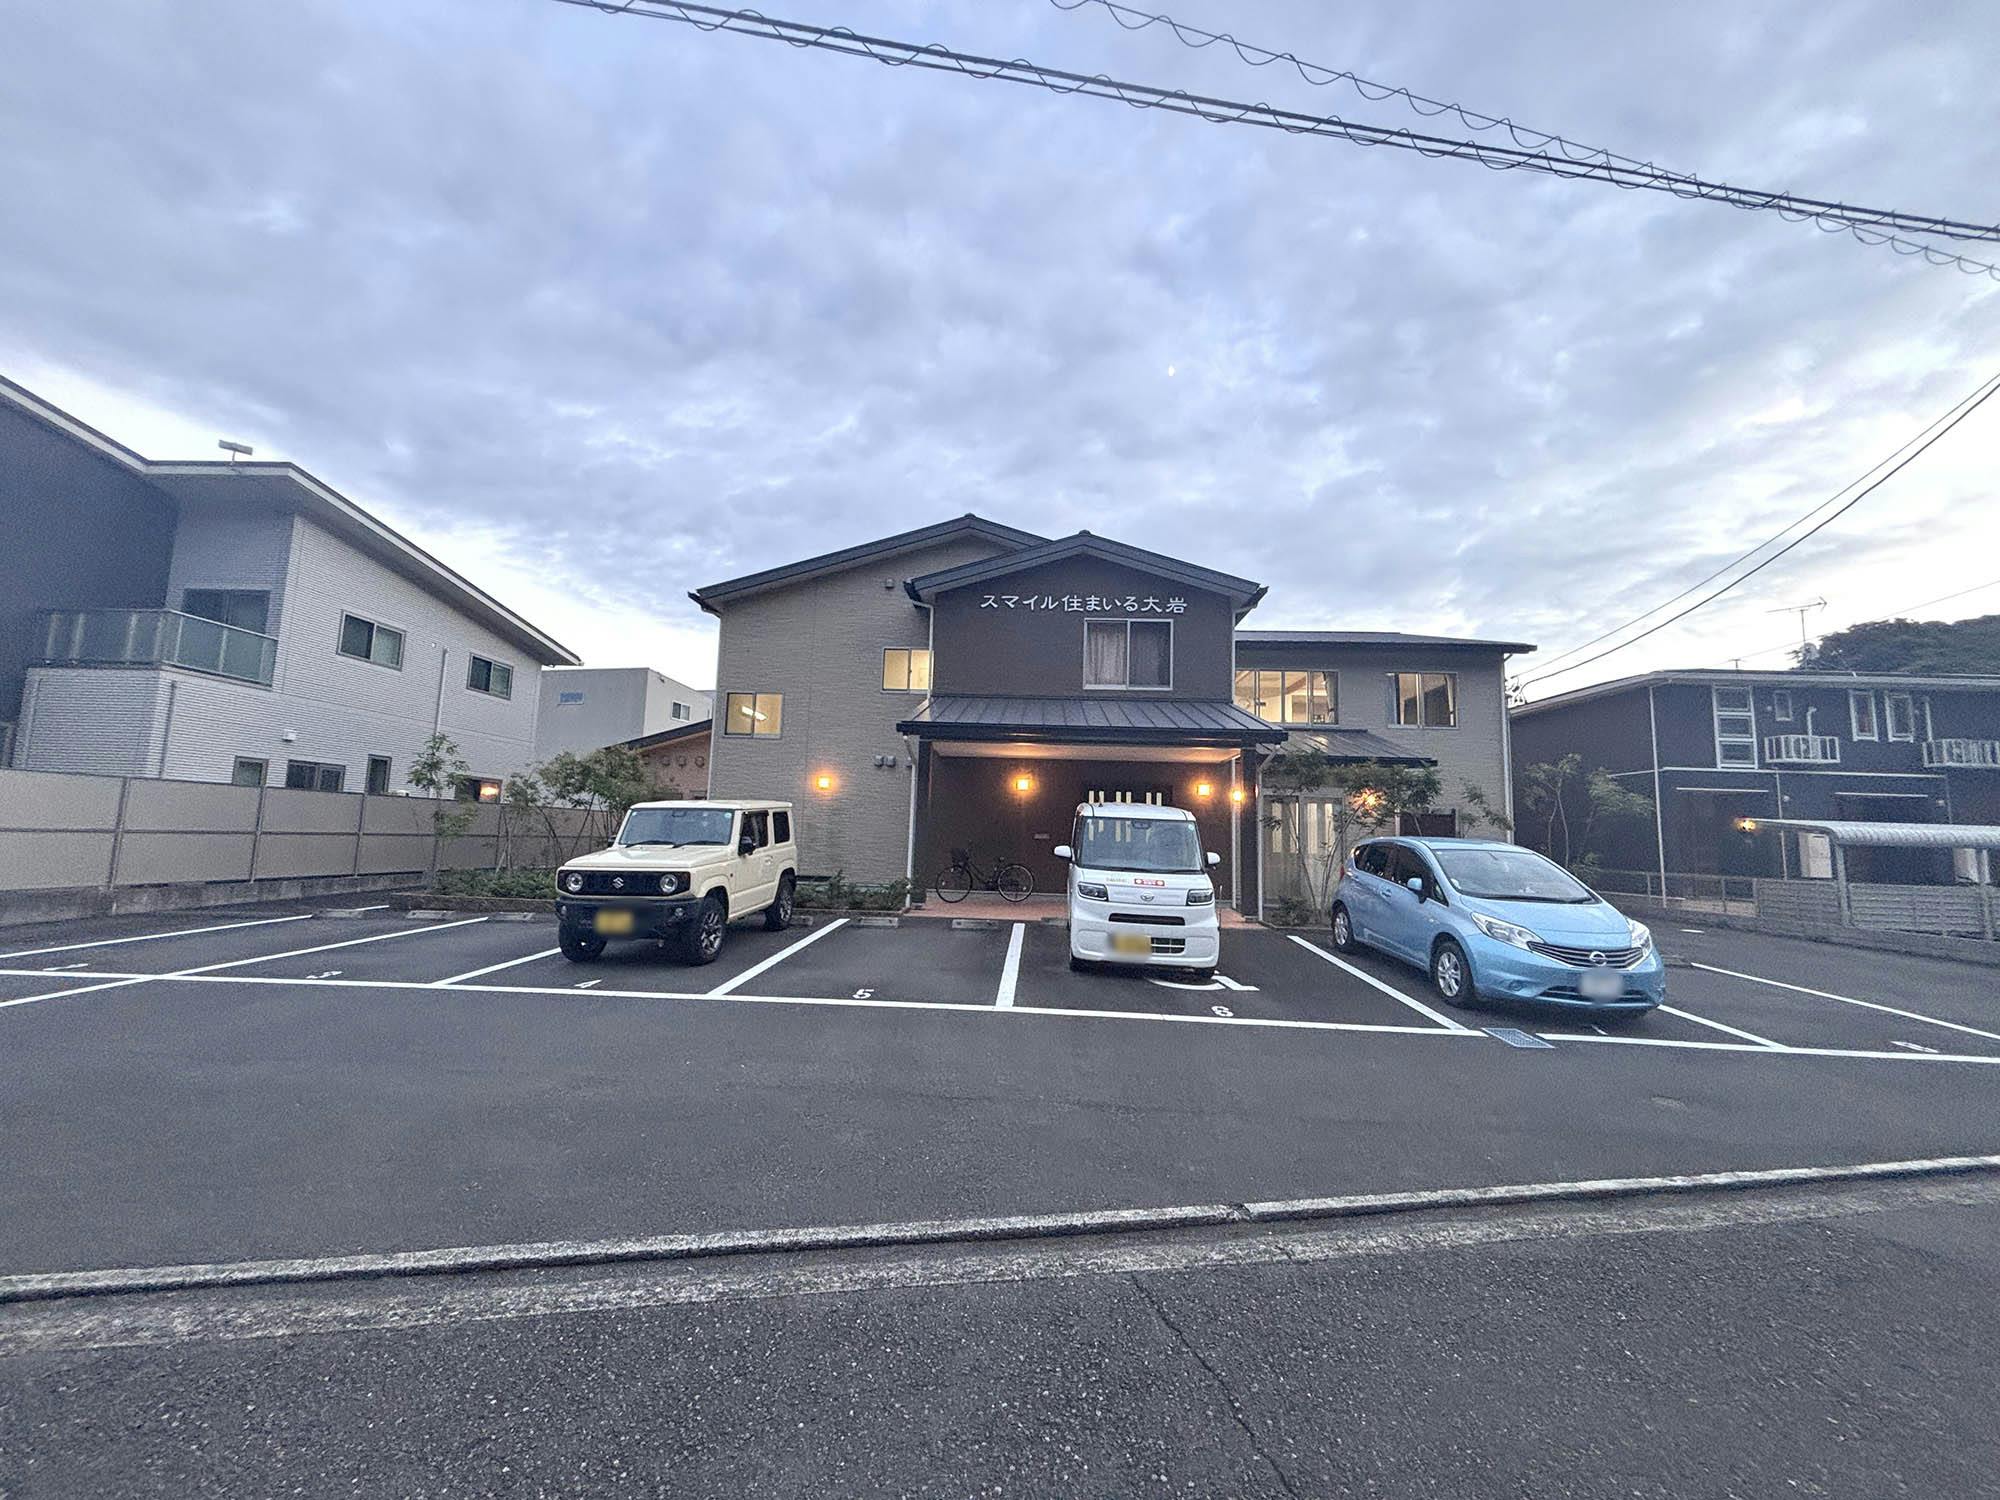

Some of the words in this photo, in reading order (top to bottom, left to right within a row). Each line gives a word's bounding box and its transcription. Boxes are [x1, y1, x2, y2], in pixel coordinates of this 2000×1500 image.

[980, 594, 1188, 614] スマイル住まいる大岩
[852, 988, 875, 999] 5
